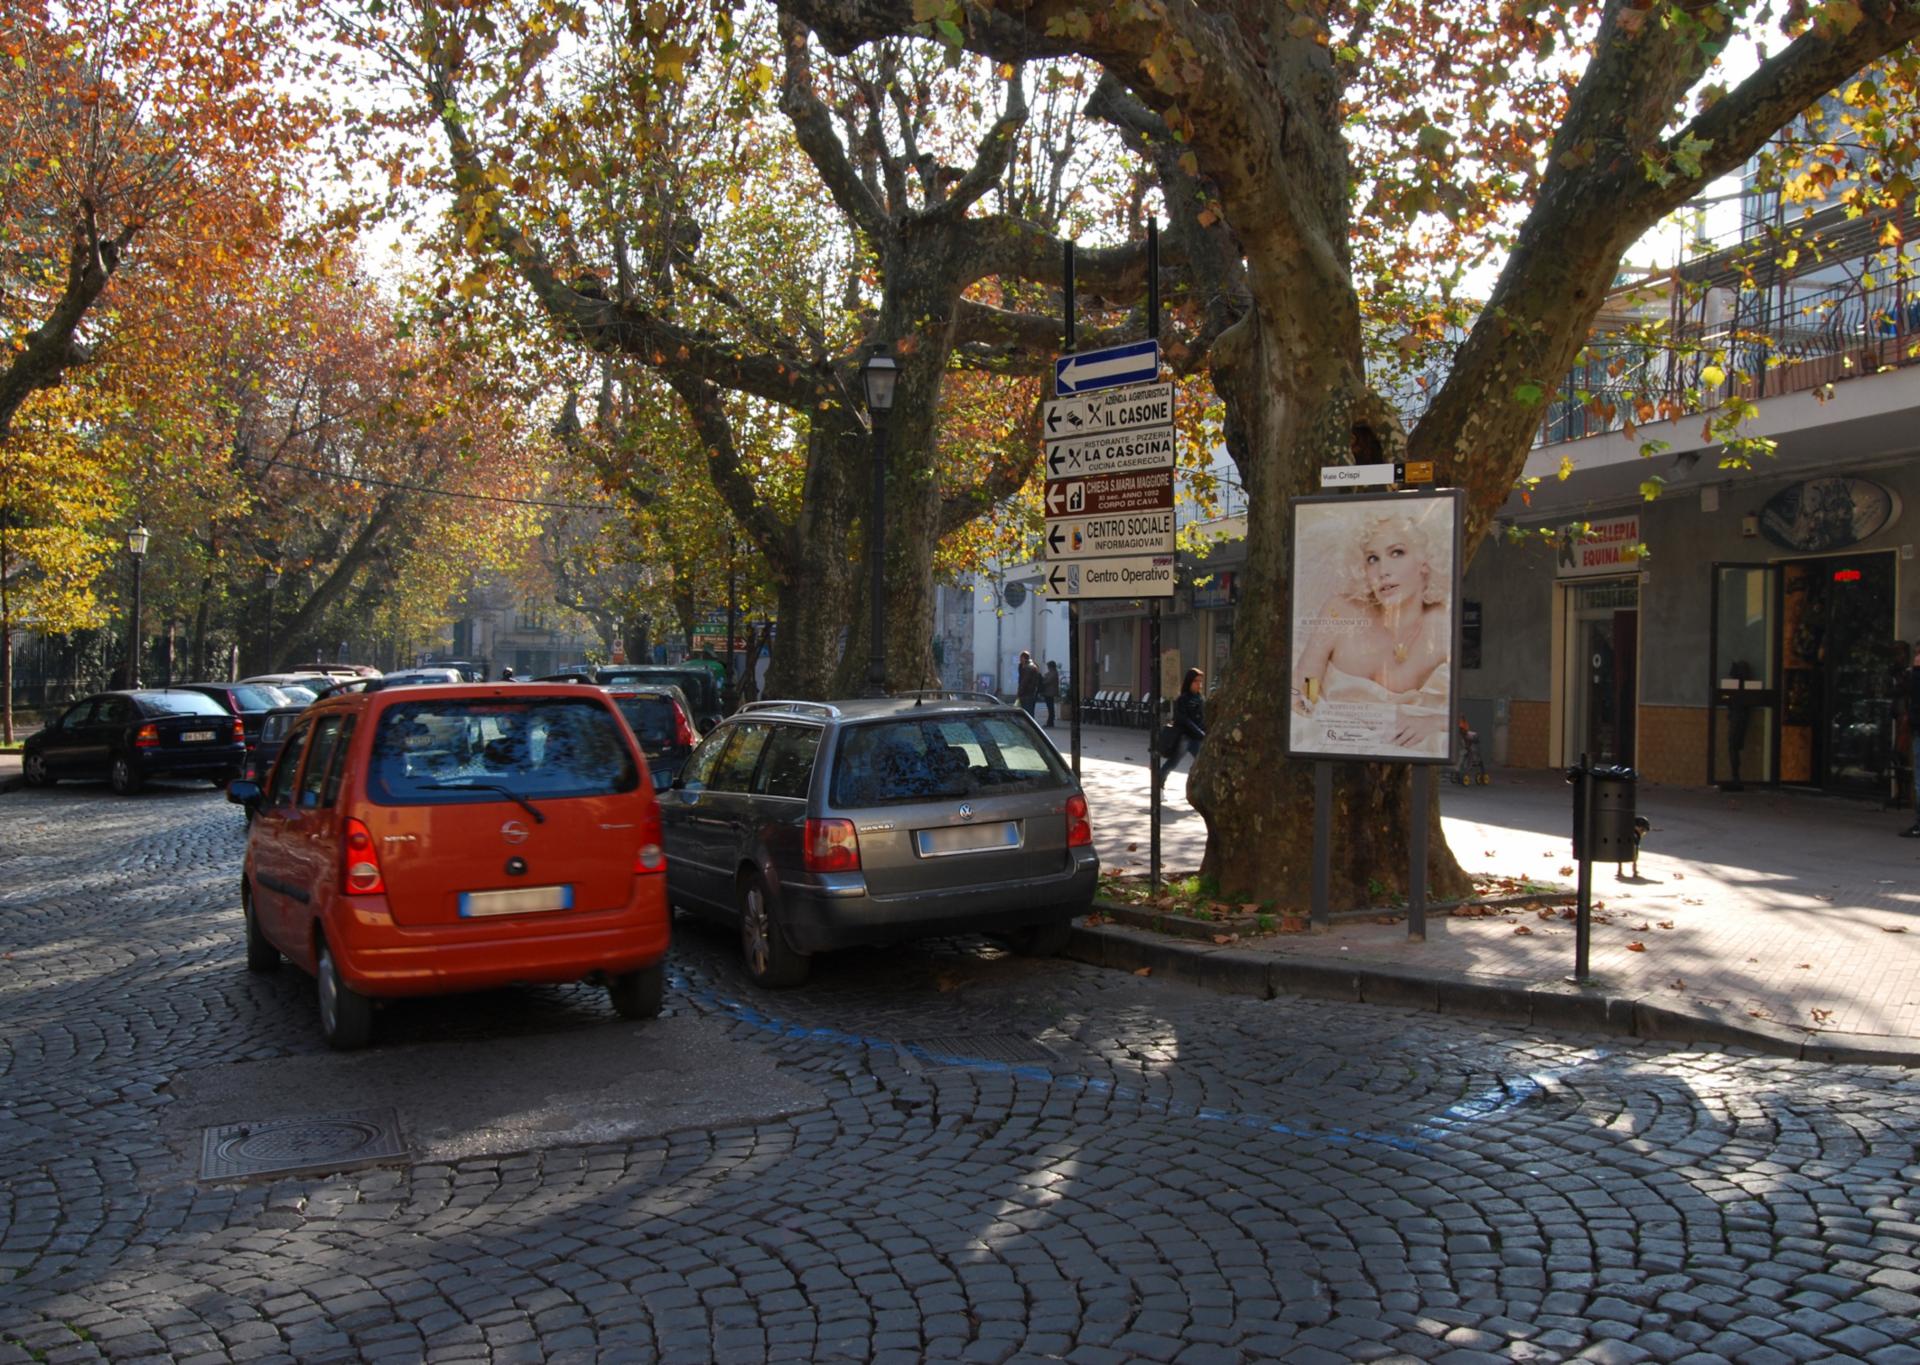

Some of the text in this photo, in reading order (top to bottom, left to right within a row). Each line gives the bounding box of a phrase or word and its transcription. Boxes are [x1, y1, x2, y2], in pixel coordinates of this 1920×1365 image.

[1105, 395, 1127, 406] AZIENDA
[1105, 402, 1168, 427] IL CASONE
[1084, 435, 1130, 448] RISTORANTE
[1136, 430, 1171, 442] PIZZERIA
[1085, 440, 1171, 462] LA CASCINA
[1088, 455, 1166, 472] CUCINA CASERECCIA
[1086, 480, 1109, 494] CHIESA
[1138, 473, 1170, 489] MAGGIORE
[1338, 471, 1360, 481] Crispi
[1098, 501, 1126, 510] CORPO
[1136, 497, 1159, 506] CAVA
[1121, 491, 1143, 500] ANNO
[1087, 515, 1170, 539] CENTRO SOCIALE
[1095, 537, 1163, 551] INFORMAGIOVANI
[1583, 546, 1619, 567] EQUINA
[1086, 566, 1170, 584] Centro Operativo
